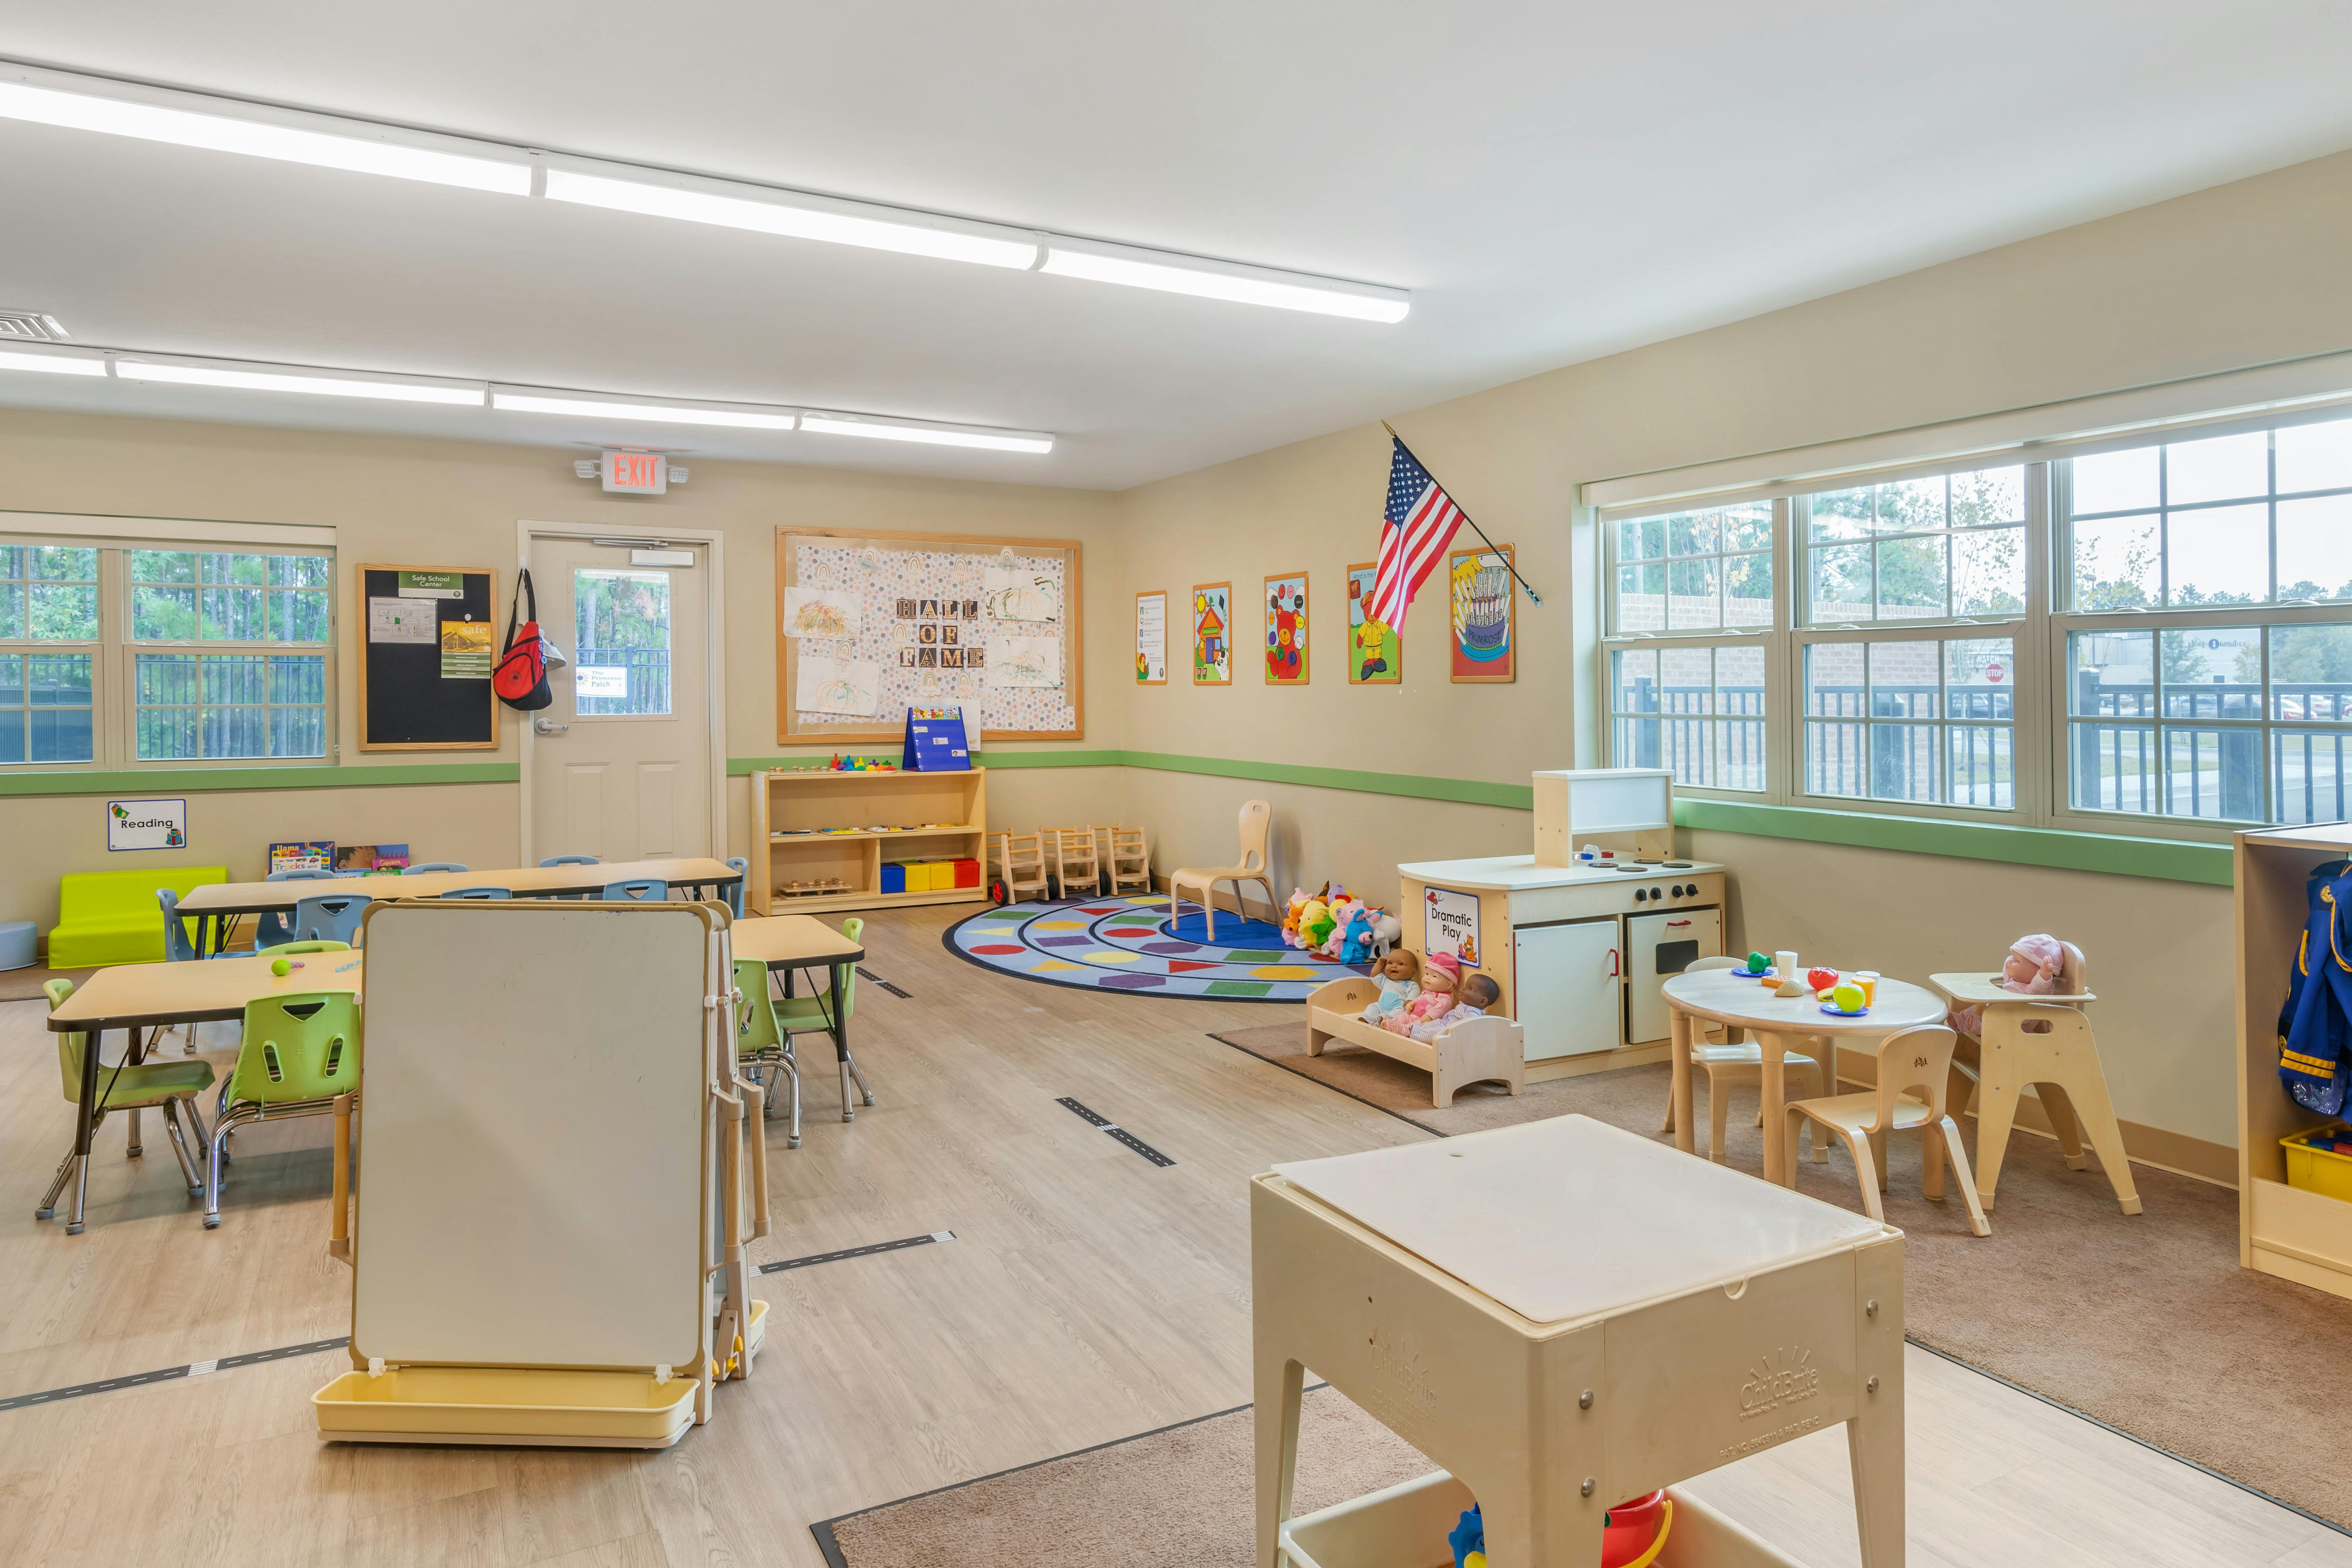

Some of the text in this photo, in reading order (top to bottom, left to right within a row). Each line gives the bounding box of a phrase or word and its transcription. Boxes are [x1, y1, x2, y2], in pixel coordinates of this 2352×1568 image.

[614, 454, 658, 487] EXIT
[897, 600, 977, 619] HALL
[462, 625, 486, 634] safe
[920, 626, 957, 643] OF
[1468, 629, 1502, 645] PRIMROSE
[901, 648, 983, 667] FAME
[121, 819, 173, 828] Reading
[1432, 908, 1472, 926] Dramatic
[1443, 924, 1461, 942] Play
[1740, 1366, 1818, 1409] ChildBrite
[1719, 1447, 1735, 1460] PAT.
[1736, 1442, 1749, 1454] NO.
[1785, 1423, 1800, 1435] PAT.
[1801, 1416, 1821, 1429] PEND.
